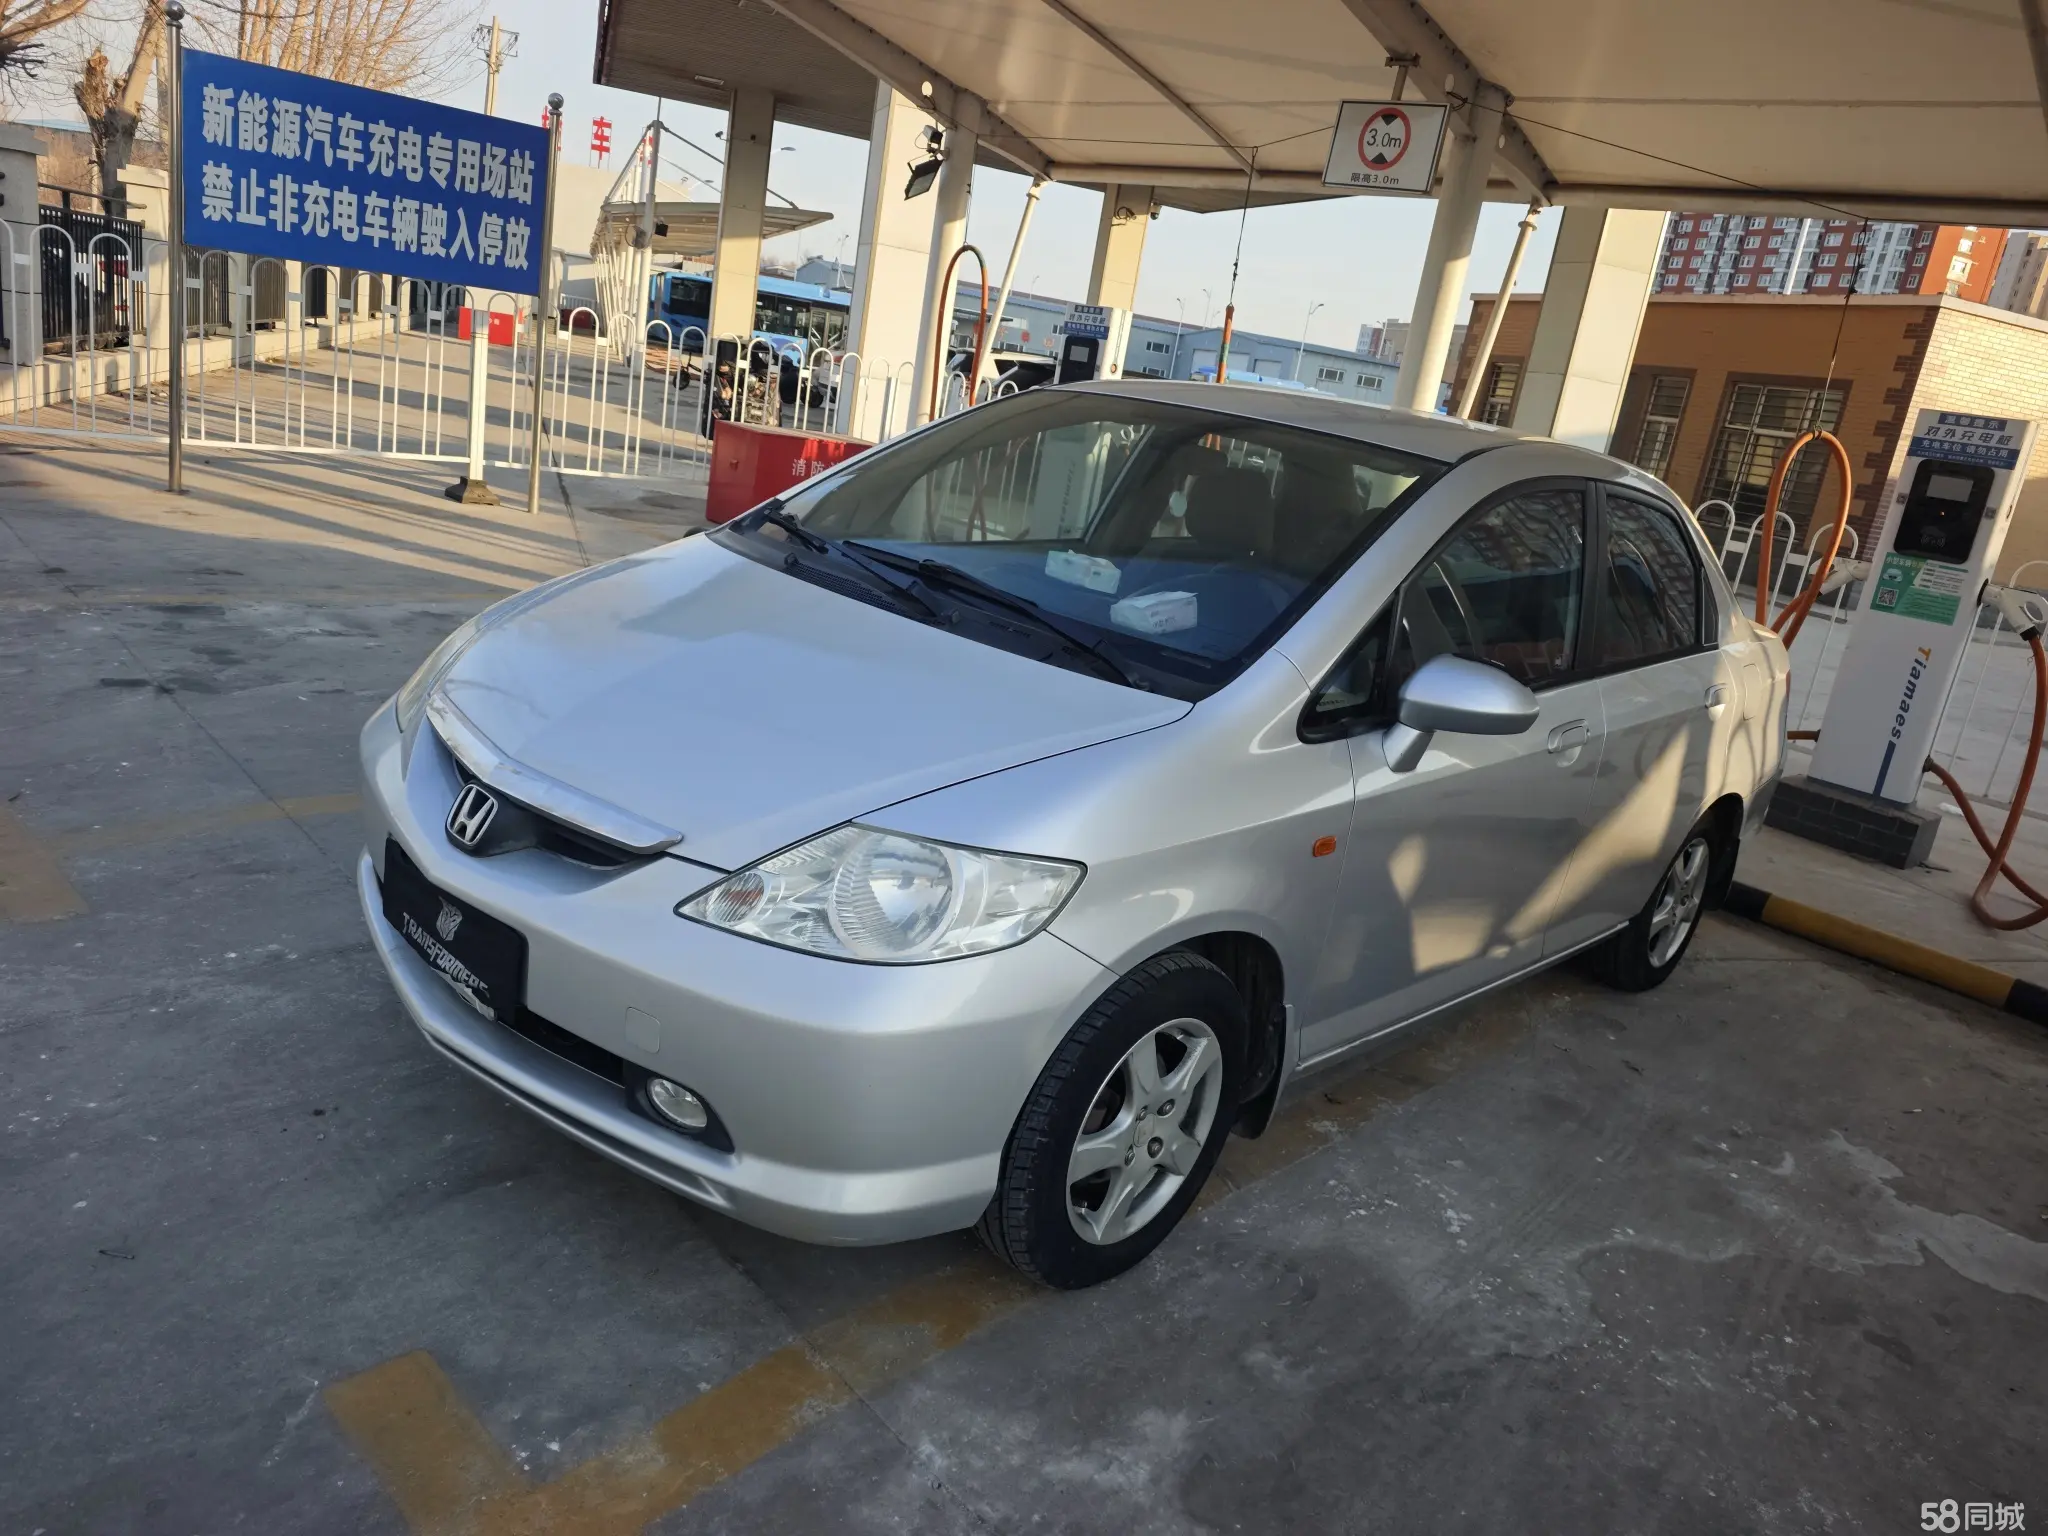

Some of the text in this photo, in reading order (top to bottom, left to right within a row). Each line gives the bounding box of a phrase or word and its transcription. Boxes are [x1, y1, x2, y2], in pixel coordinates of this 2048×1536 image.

[202, 83, 535, 206] 新能源汽车充电专用场站
[1366, 128, 1402, 149] 3.0m
[202, 160, 531, 270] 禁止非充电车辆驶入停放
[1921, 438, 2009, 458] 充电车位 请勿占用
[1924, 425, 2014, 446] 对外充电桩
[1891, 646, 1932, 740] Tiamaes
[402, 911, 490, 998] TRANSFORMERS
